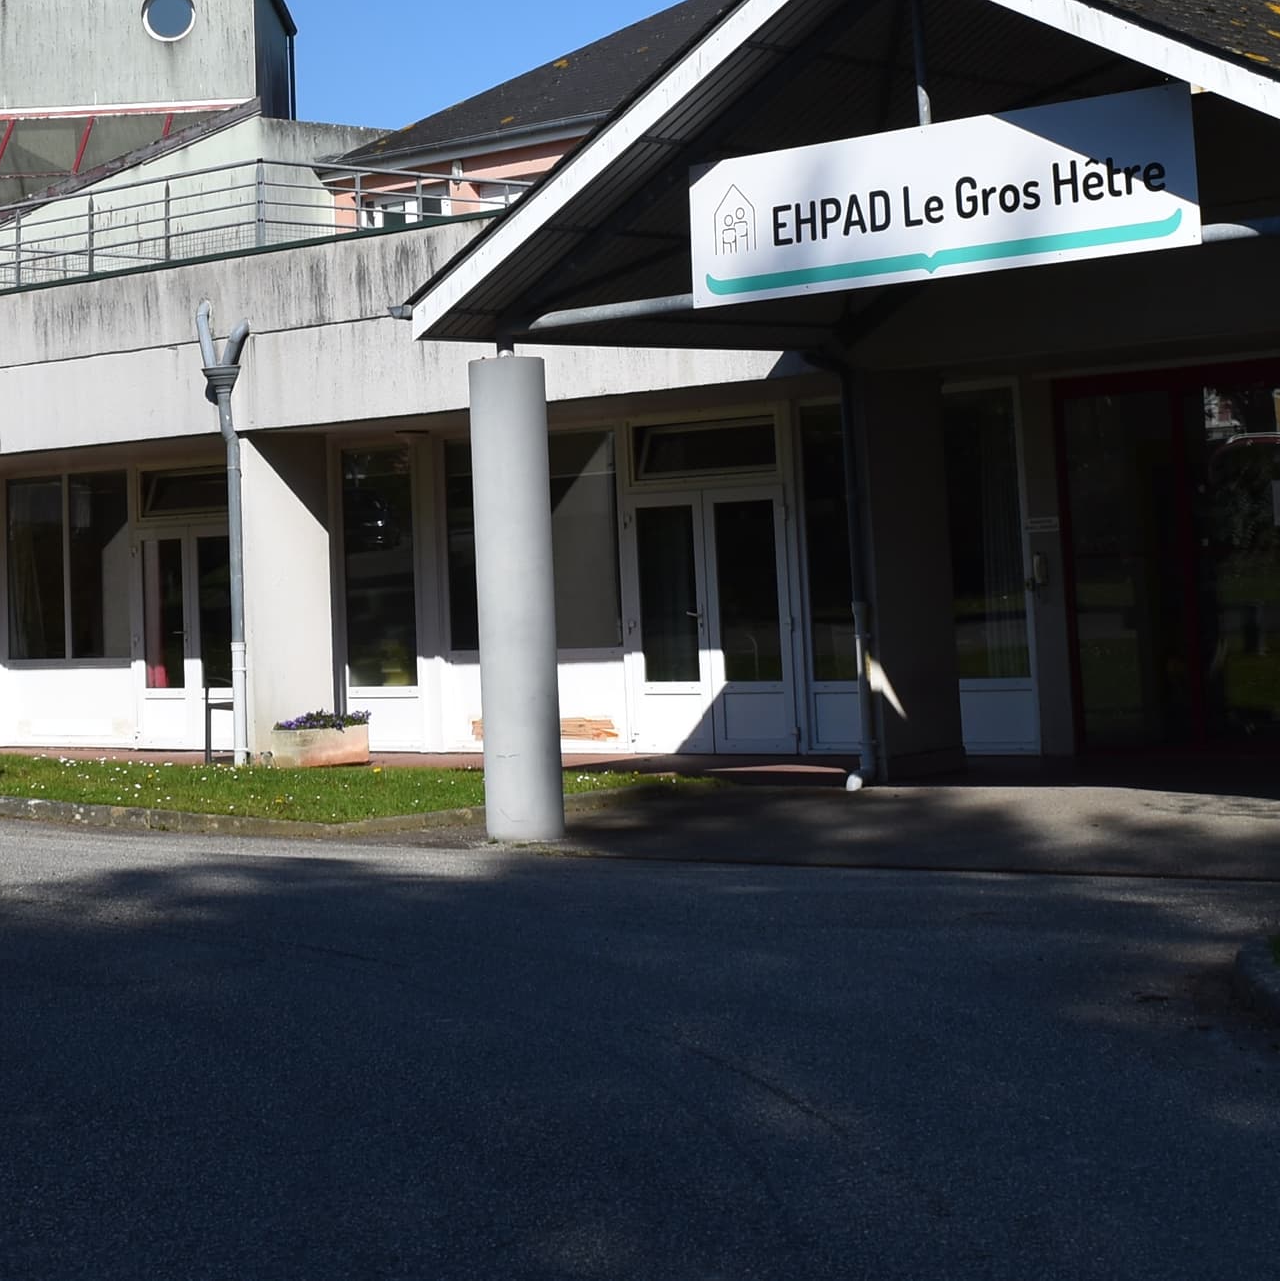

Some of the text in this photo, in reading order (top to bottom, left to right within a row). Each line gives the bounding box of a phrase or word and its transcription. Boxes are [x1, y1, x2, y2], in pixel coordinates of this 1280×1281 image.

[773, 156, 1166, 246] EHPAD Le Gros Hêtre
